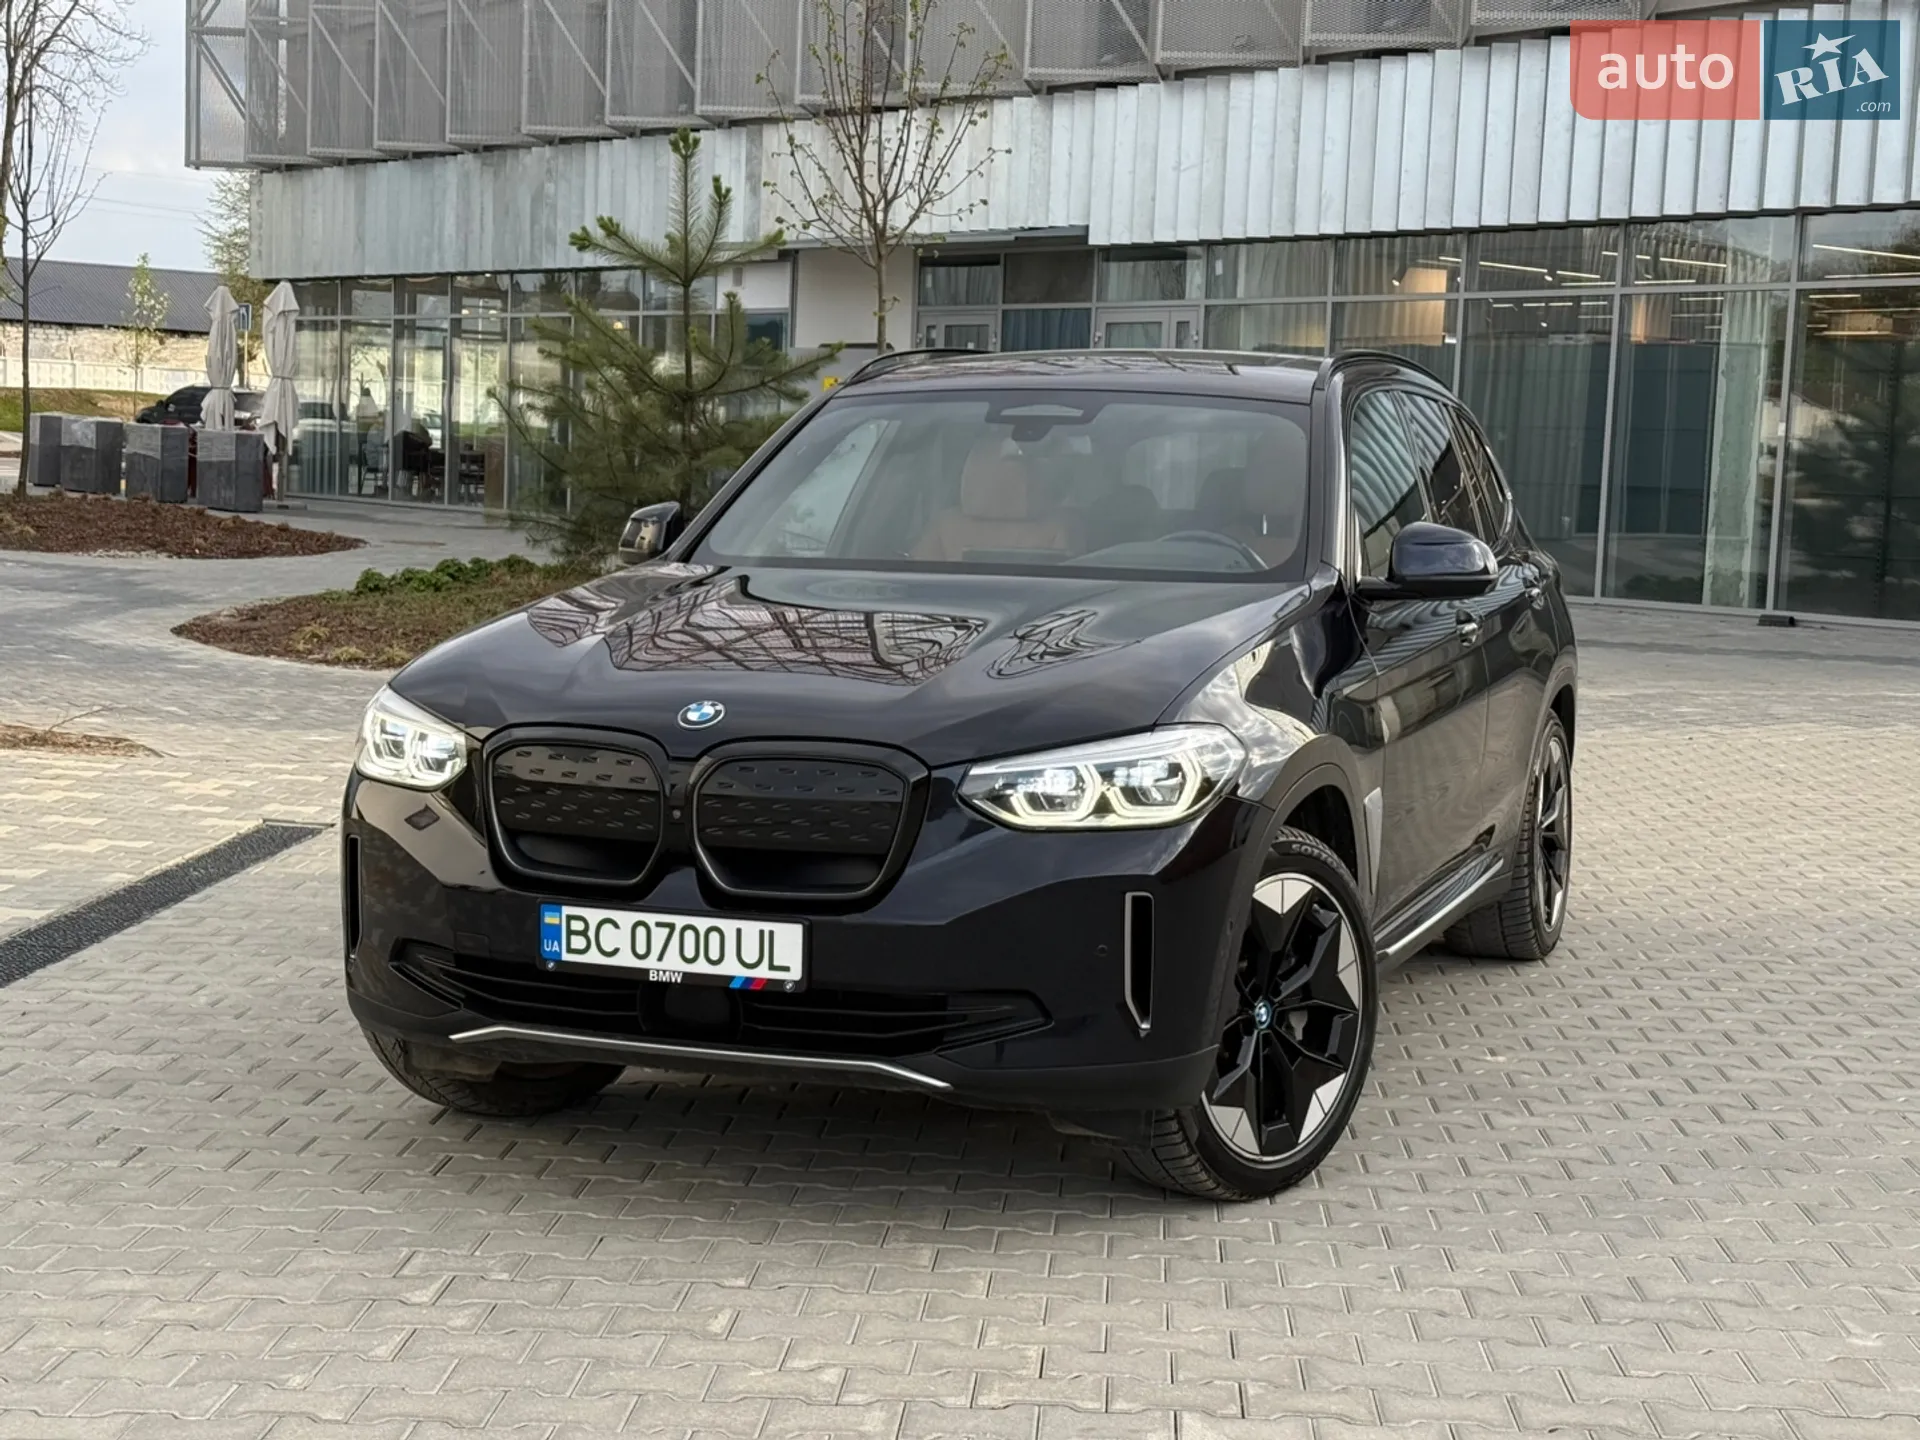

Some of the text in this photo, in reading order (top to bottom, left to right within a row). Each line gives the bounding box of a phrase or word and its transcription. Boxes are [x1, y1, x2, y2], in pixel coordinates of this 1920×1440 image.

[543, 938, 560, 953] UA
[565, 913, 791, 972] BC 0700 UL
[649, 969, 683, 984] BMW
